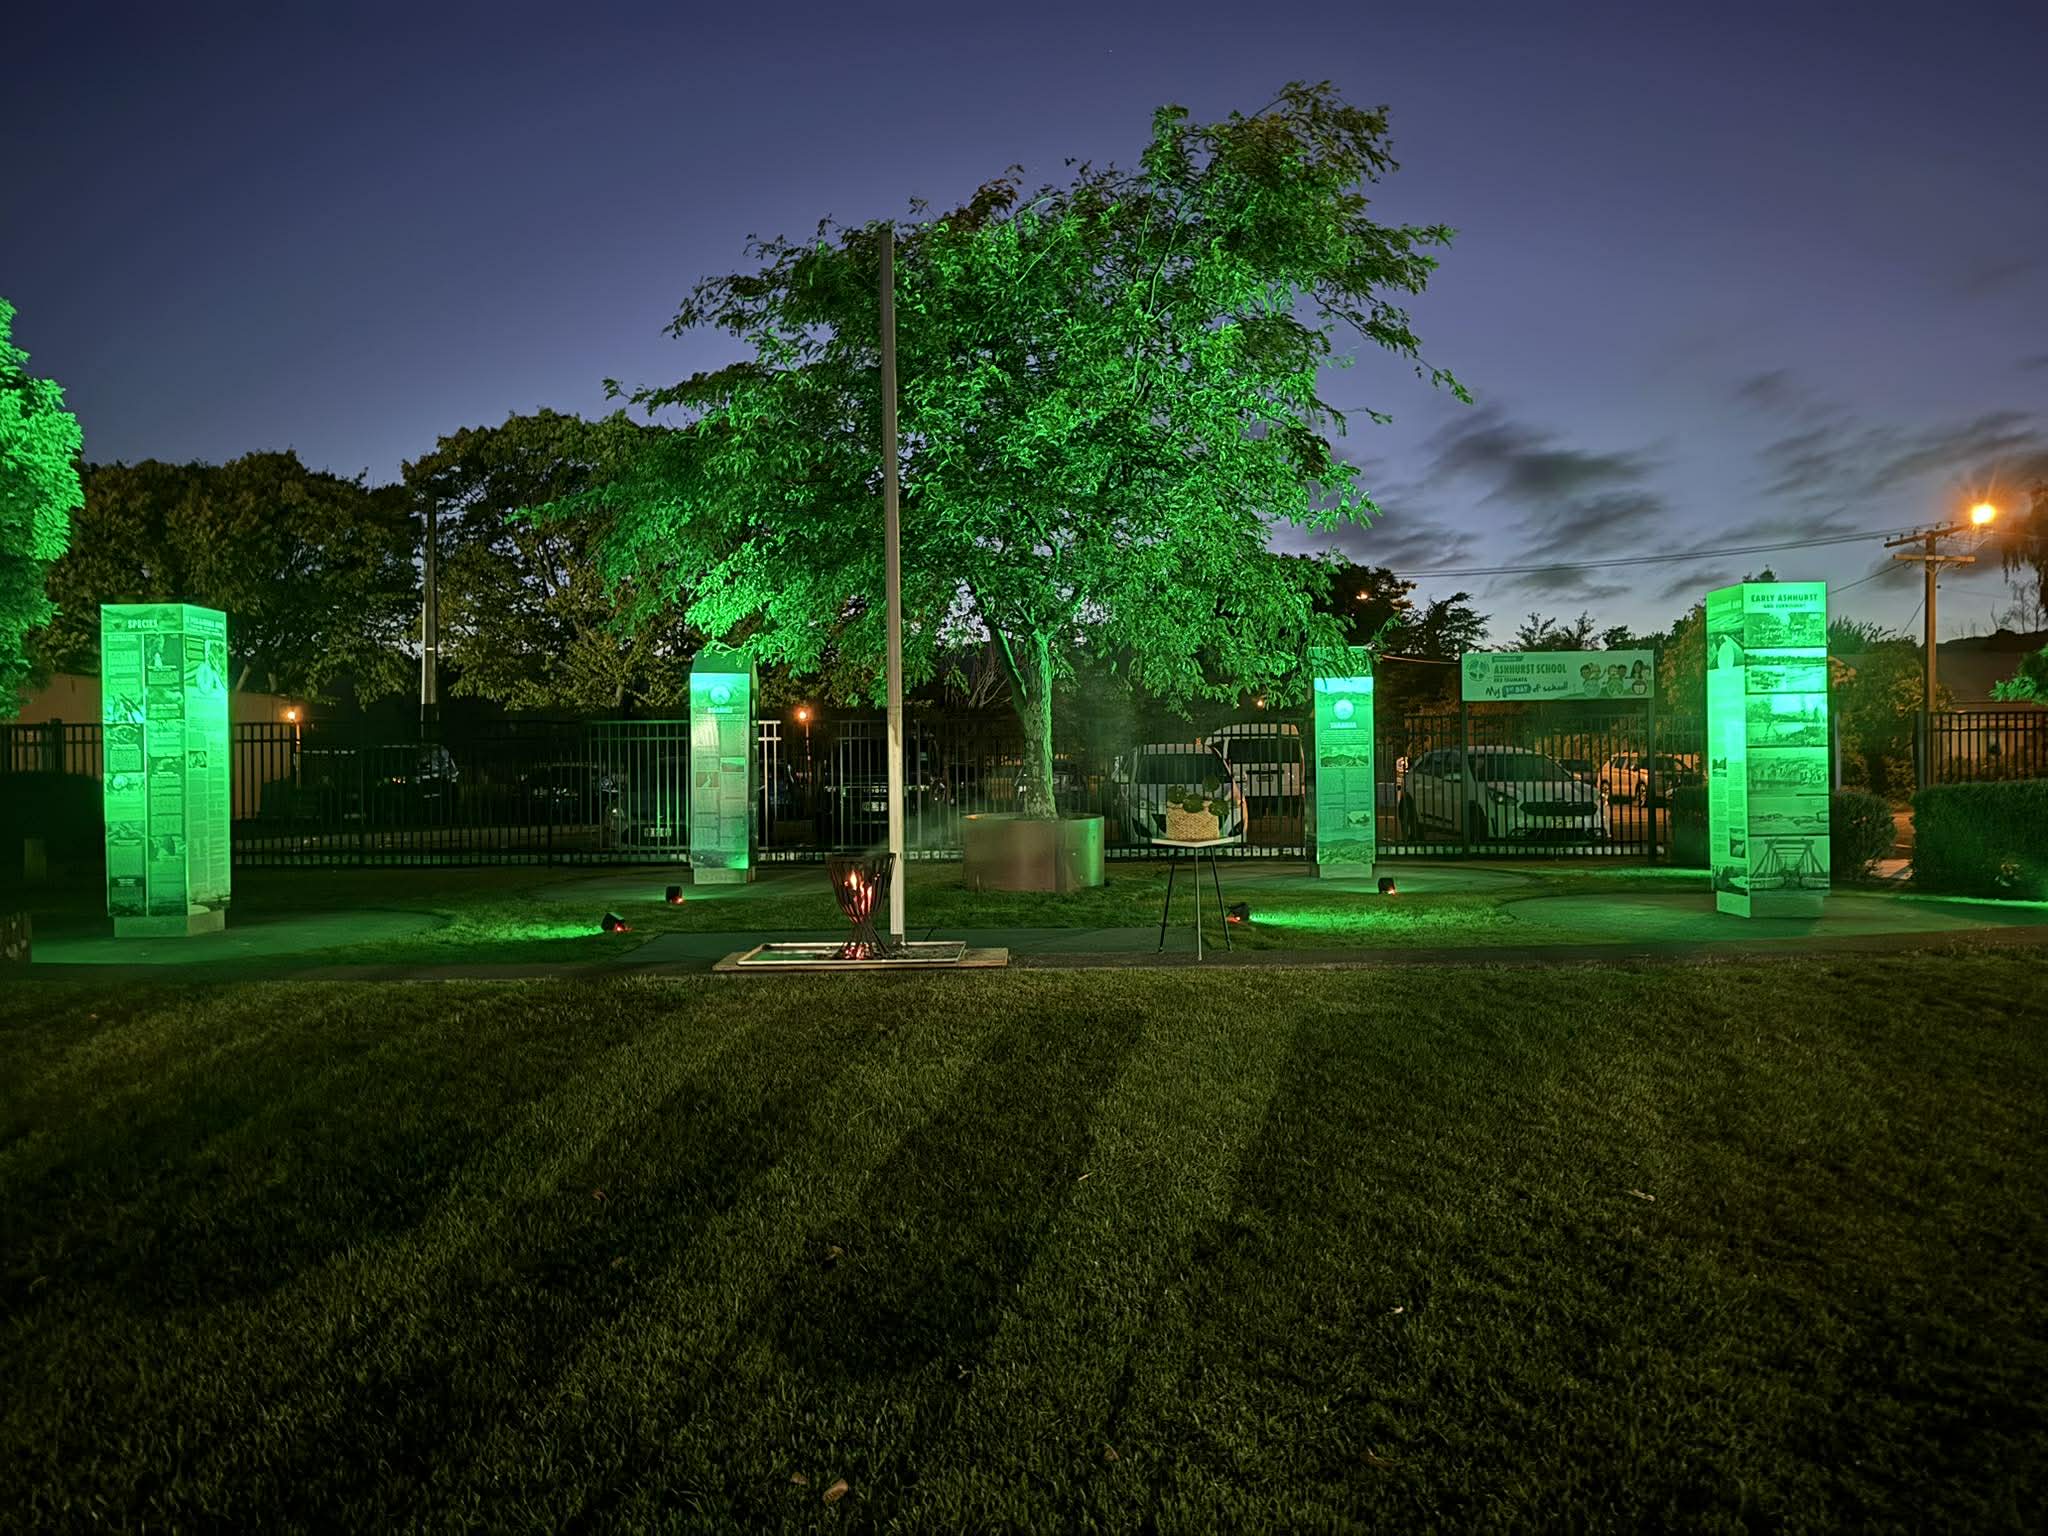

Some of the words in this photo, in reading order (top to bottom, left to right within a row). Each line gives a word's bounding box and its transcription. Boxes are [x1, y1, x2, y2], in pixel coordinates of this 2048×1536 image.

[1751, 594, 1774, 602] EARLY
[1777, 593, 1818, 602] ASHHURST
[127, 619, 159, 629] SPECIES
[1494, 664, 1535, 675] ASHHURST
[1536, 663, 1567, 674] SCHOOL
[1486, 687, 1501, 698] My
